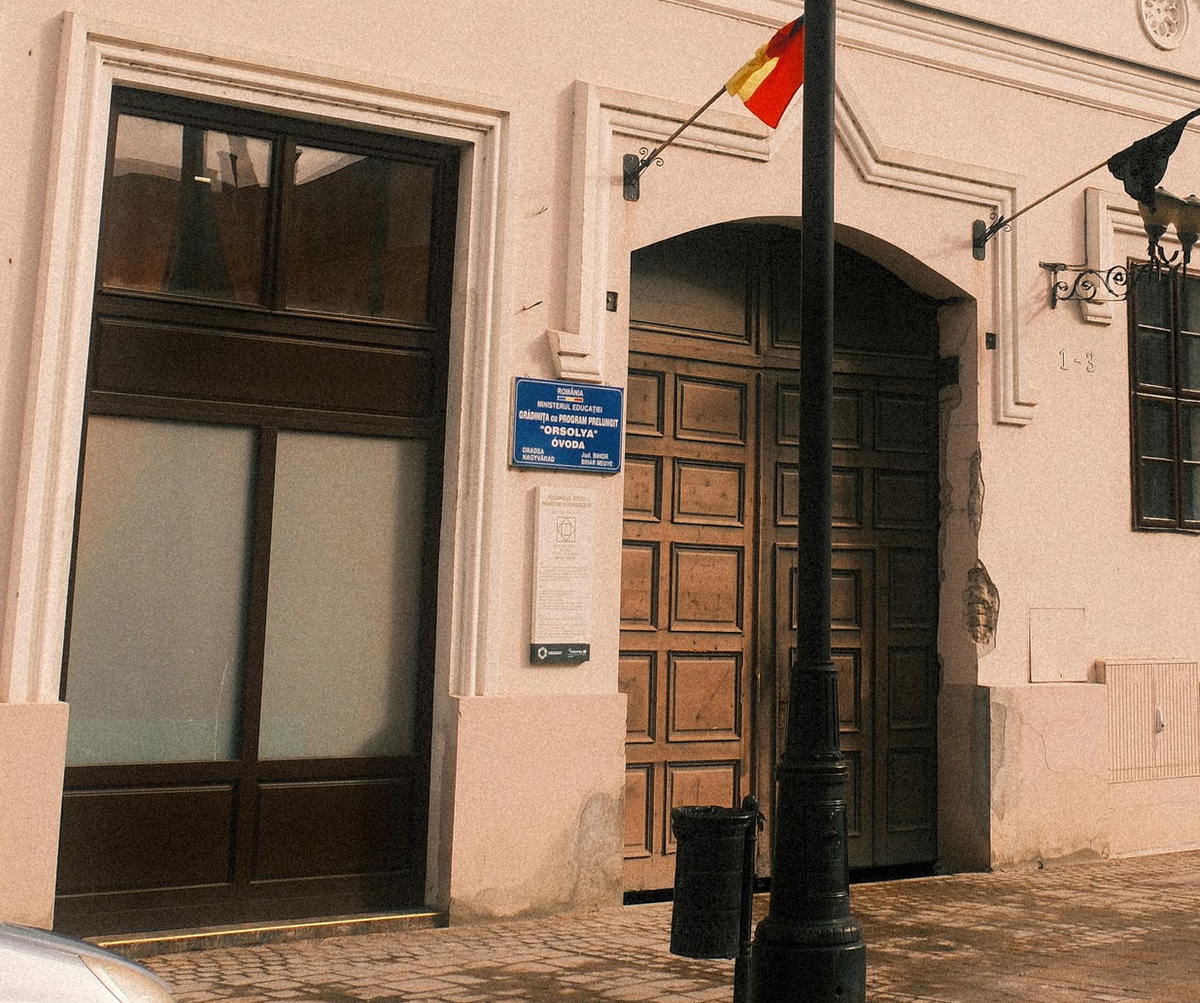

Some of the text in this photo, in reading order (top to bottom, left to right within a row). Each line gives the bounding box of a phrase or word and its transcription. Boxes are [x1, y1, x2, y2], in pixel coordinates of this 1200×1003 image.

[557, 387, 584, 396] ROMÂNIA
[537, 400, 571, 411] MINISTERUL
[550, 415, 558, 423] cu
[558, 414, 587, 425] PROGRAM
[588, 417, 619, 428] PRELUNGIT
[540, 425, 598, 438] "ORSOLYA"
[551, 437, 585, 449] ÓVODA
[522, 446, 545, 455] ORADEA
